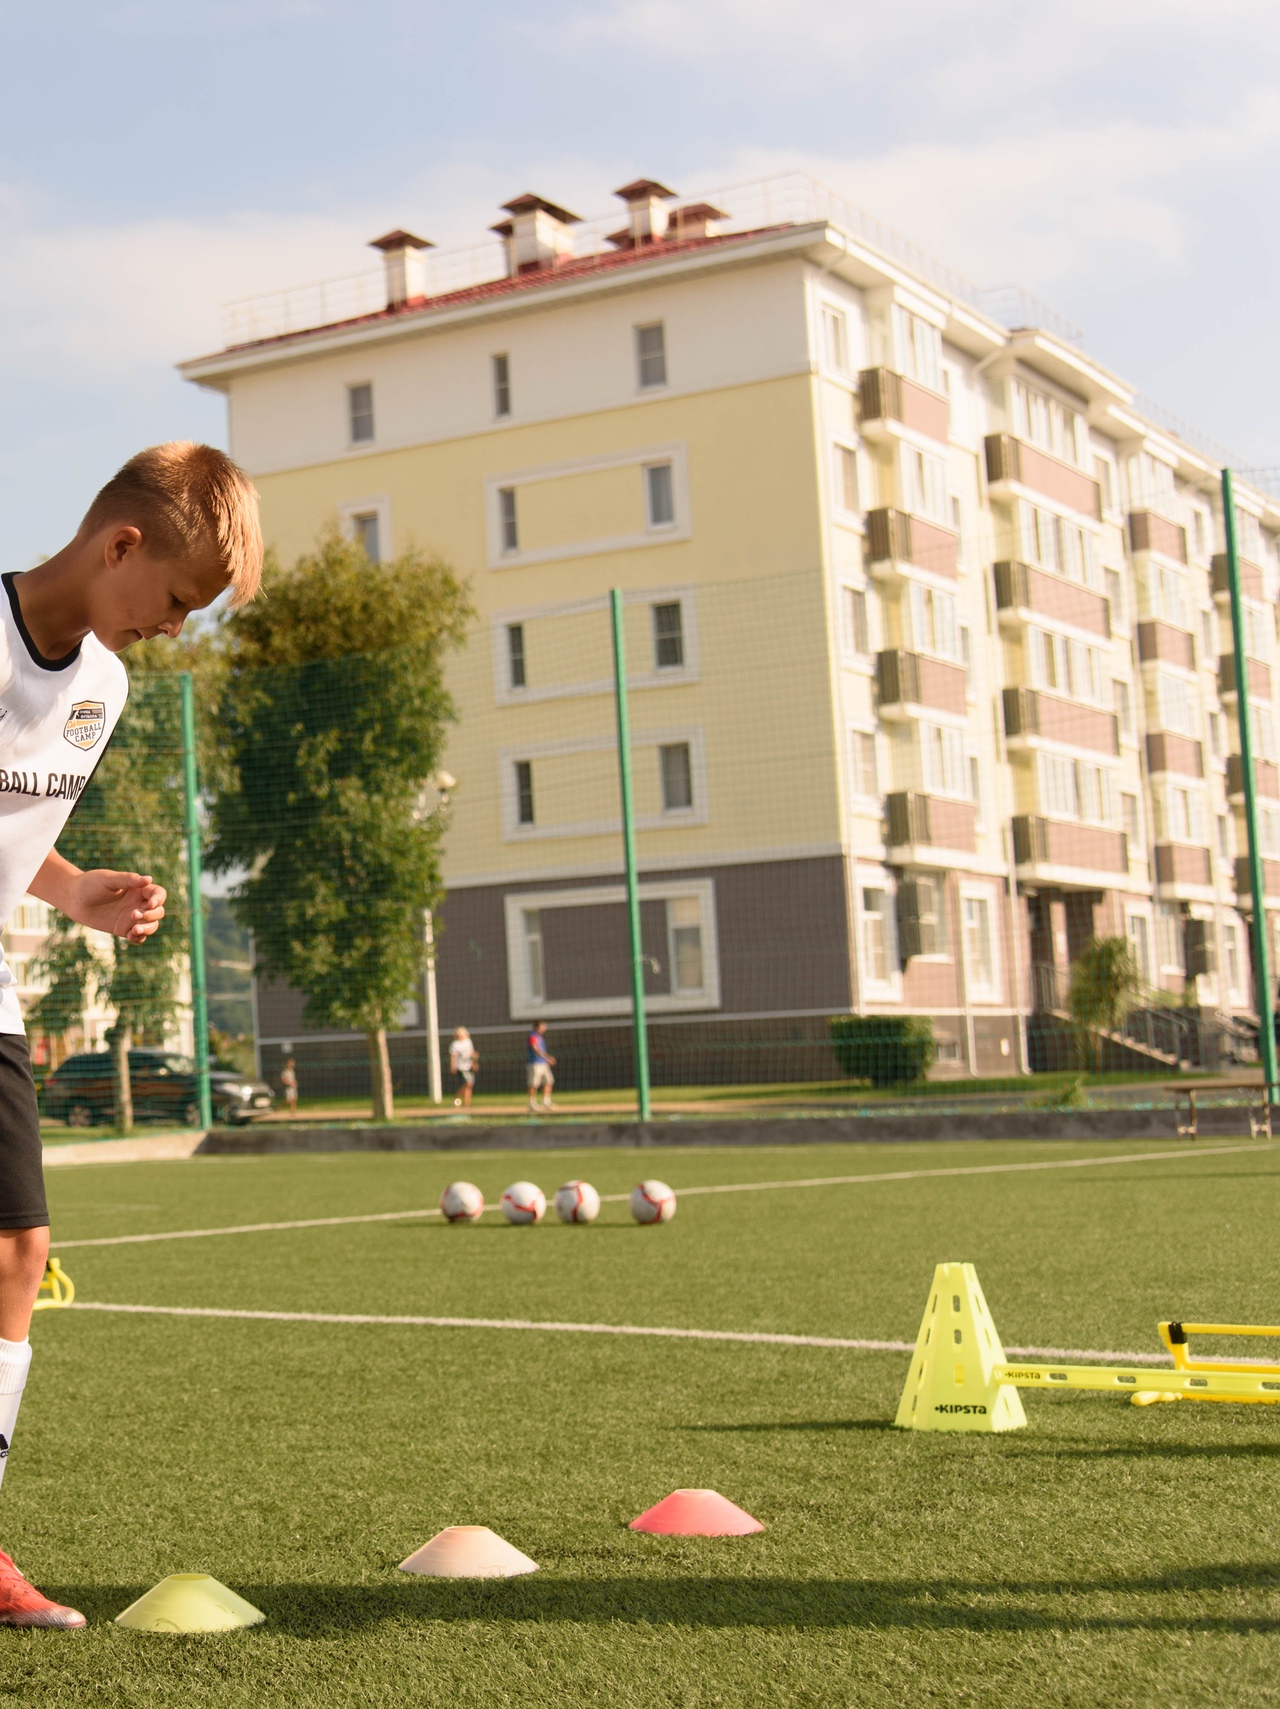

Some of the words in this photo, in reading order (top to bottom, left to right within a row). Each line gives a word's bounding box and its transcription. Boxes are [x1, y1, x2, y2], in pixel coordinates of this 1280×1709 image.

[66, 723, 101, 737] FOOTBALL
[75, 732, 96, 742] CAMP
[46, 772, 87, 801] CAMP
